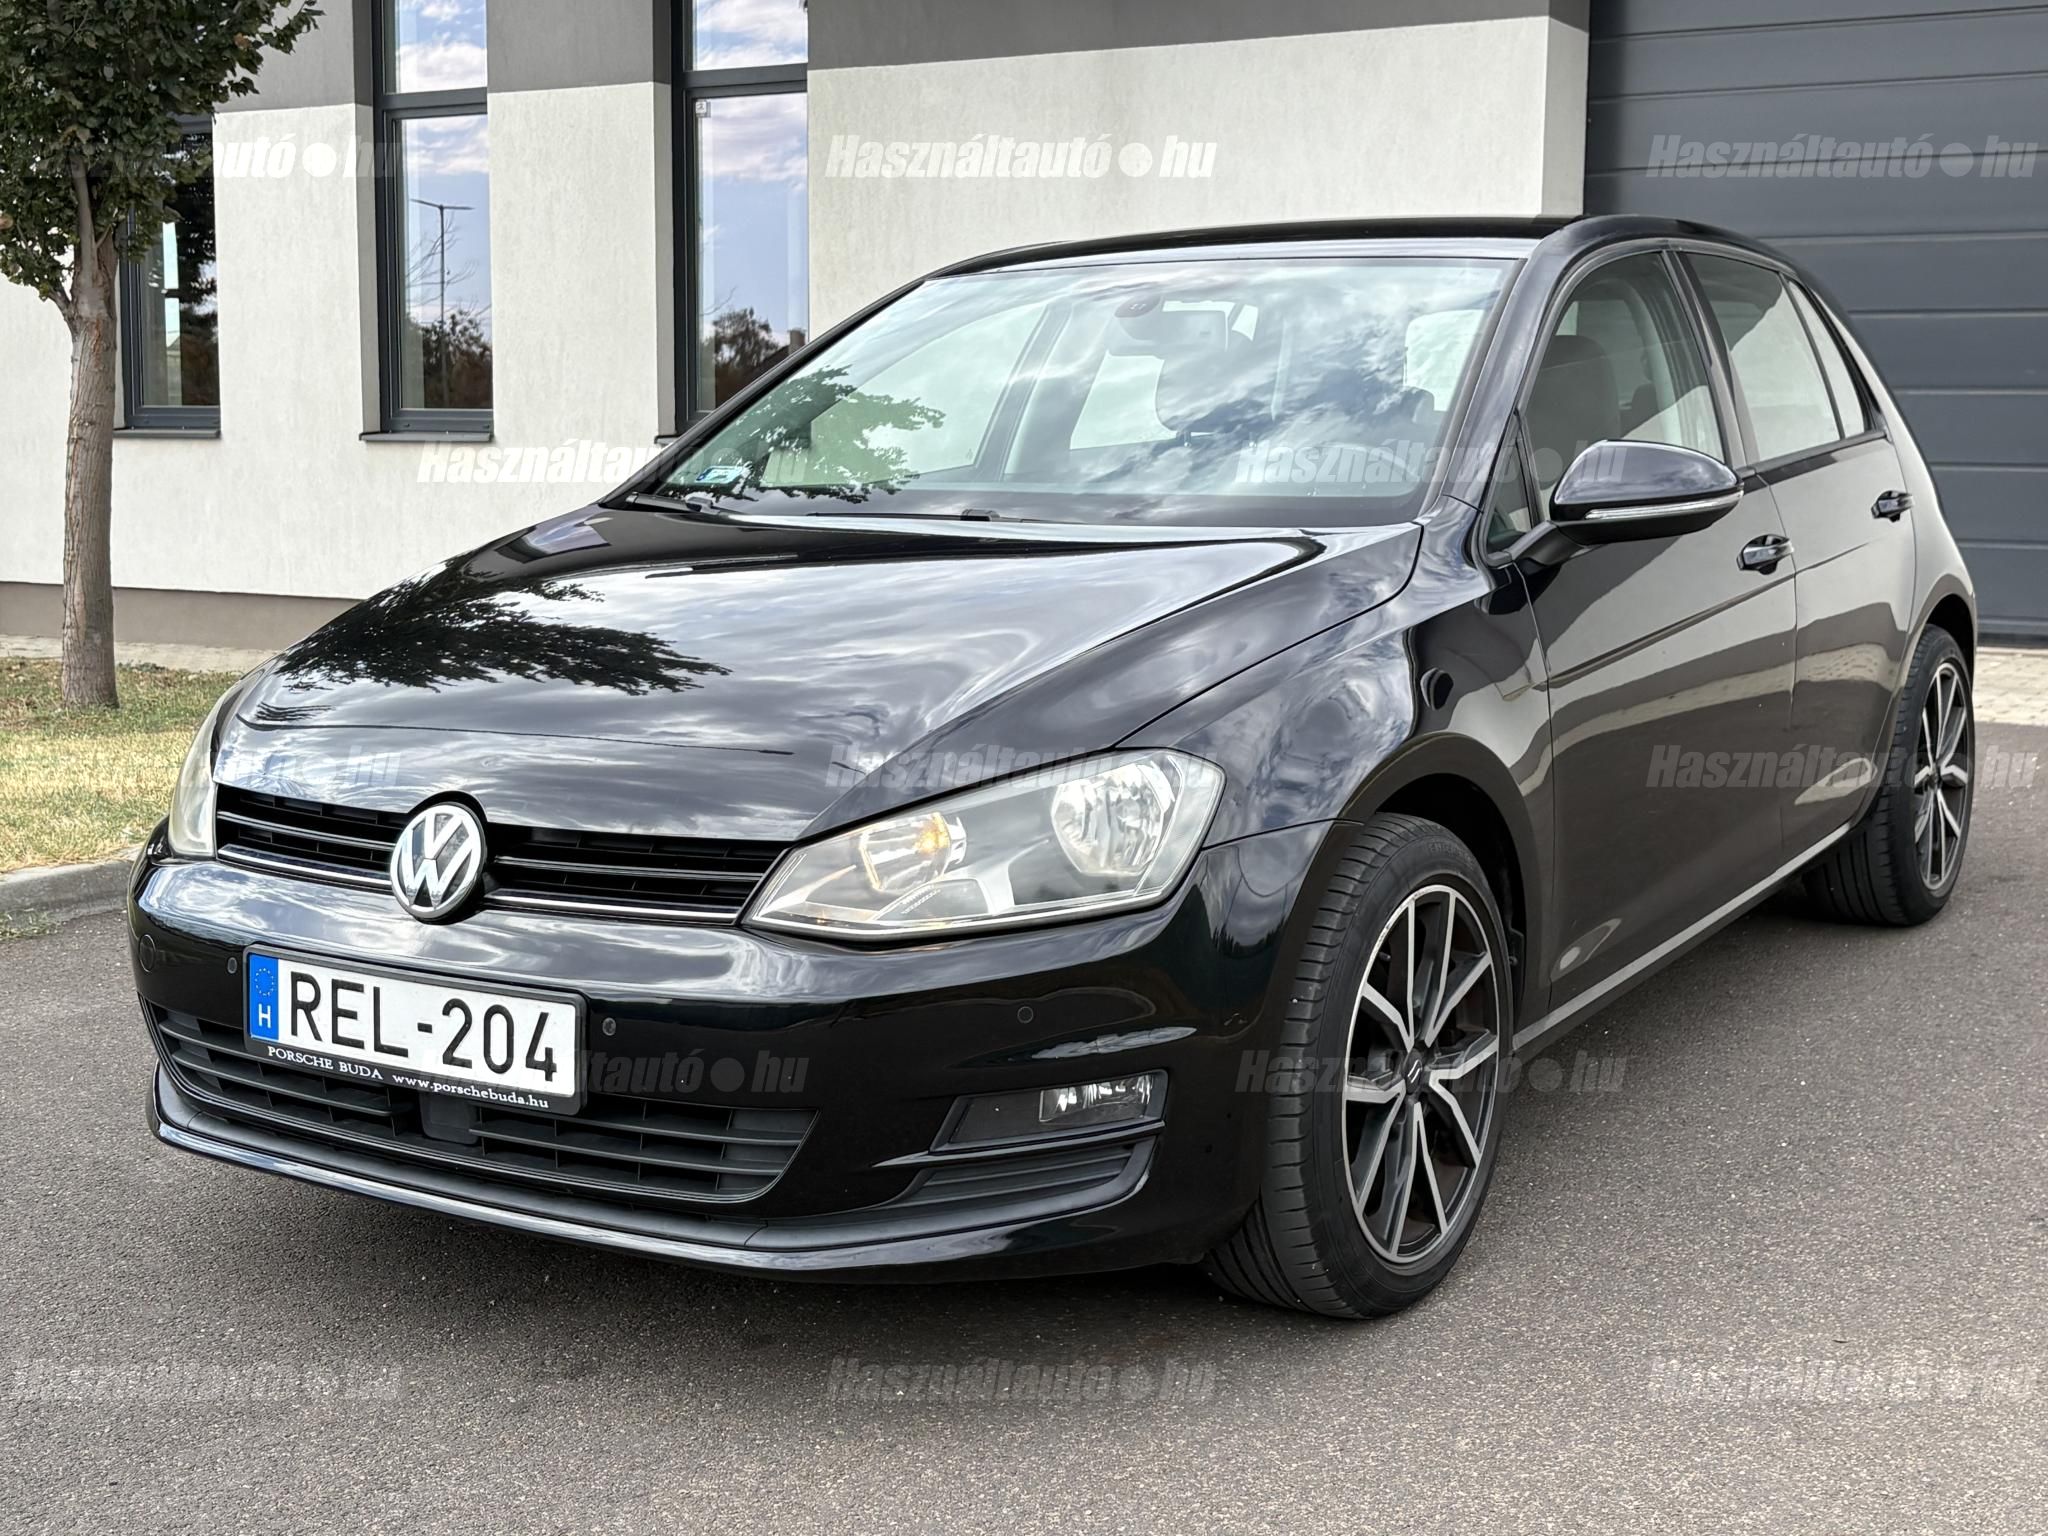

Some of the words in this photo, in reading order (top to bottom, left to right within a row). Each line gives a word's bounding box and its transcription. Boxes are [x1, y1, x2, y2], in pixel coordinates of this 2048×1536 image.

[257, 1003, 272, 1029] H
[290, 970, 558, 1083] REL-204
[267, 1045, 334, 1070] PORSCHE
[338, 1061, 383, 1080] BUDA
[392, 1074, 549, 1109] www.porschebuda.hu
